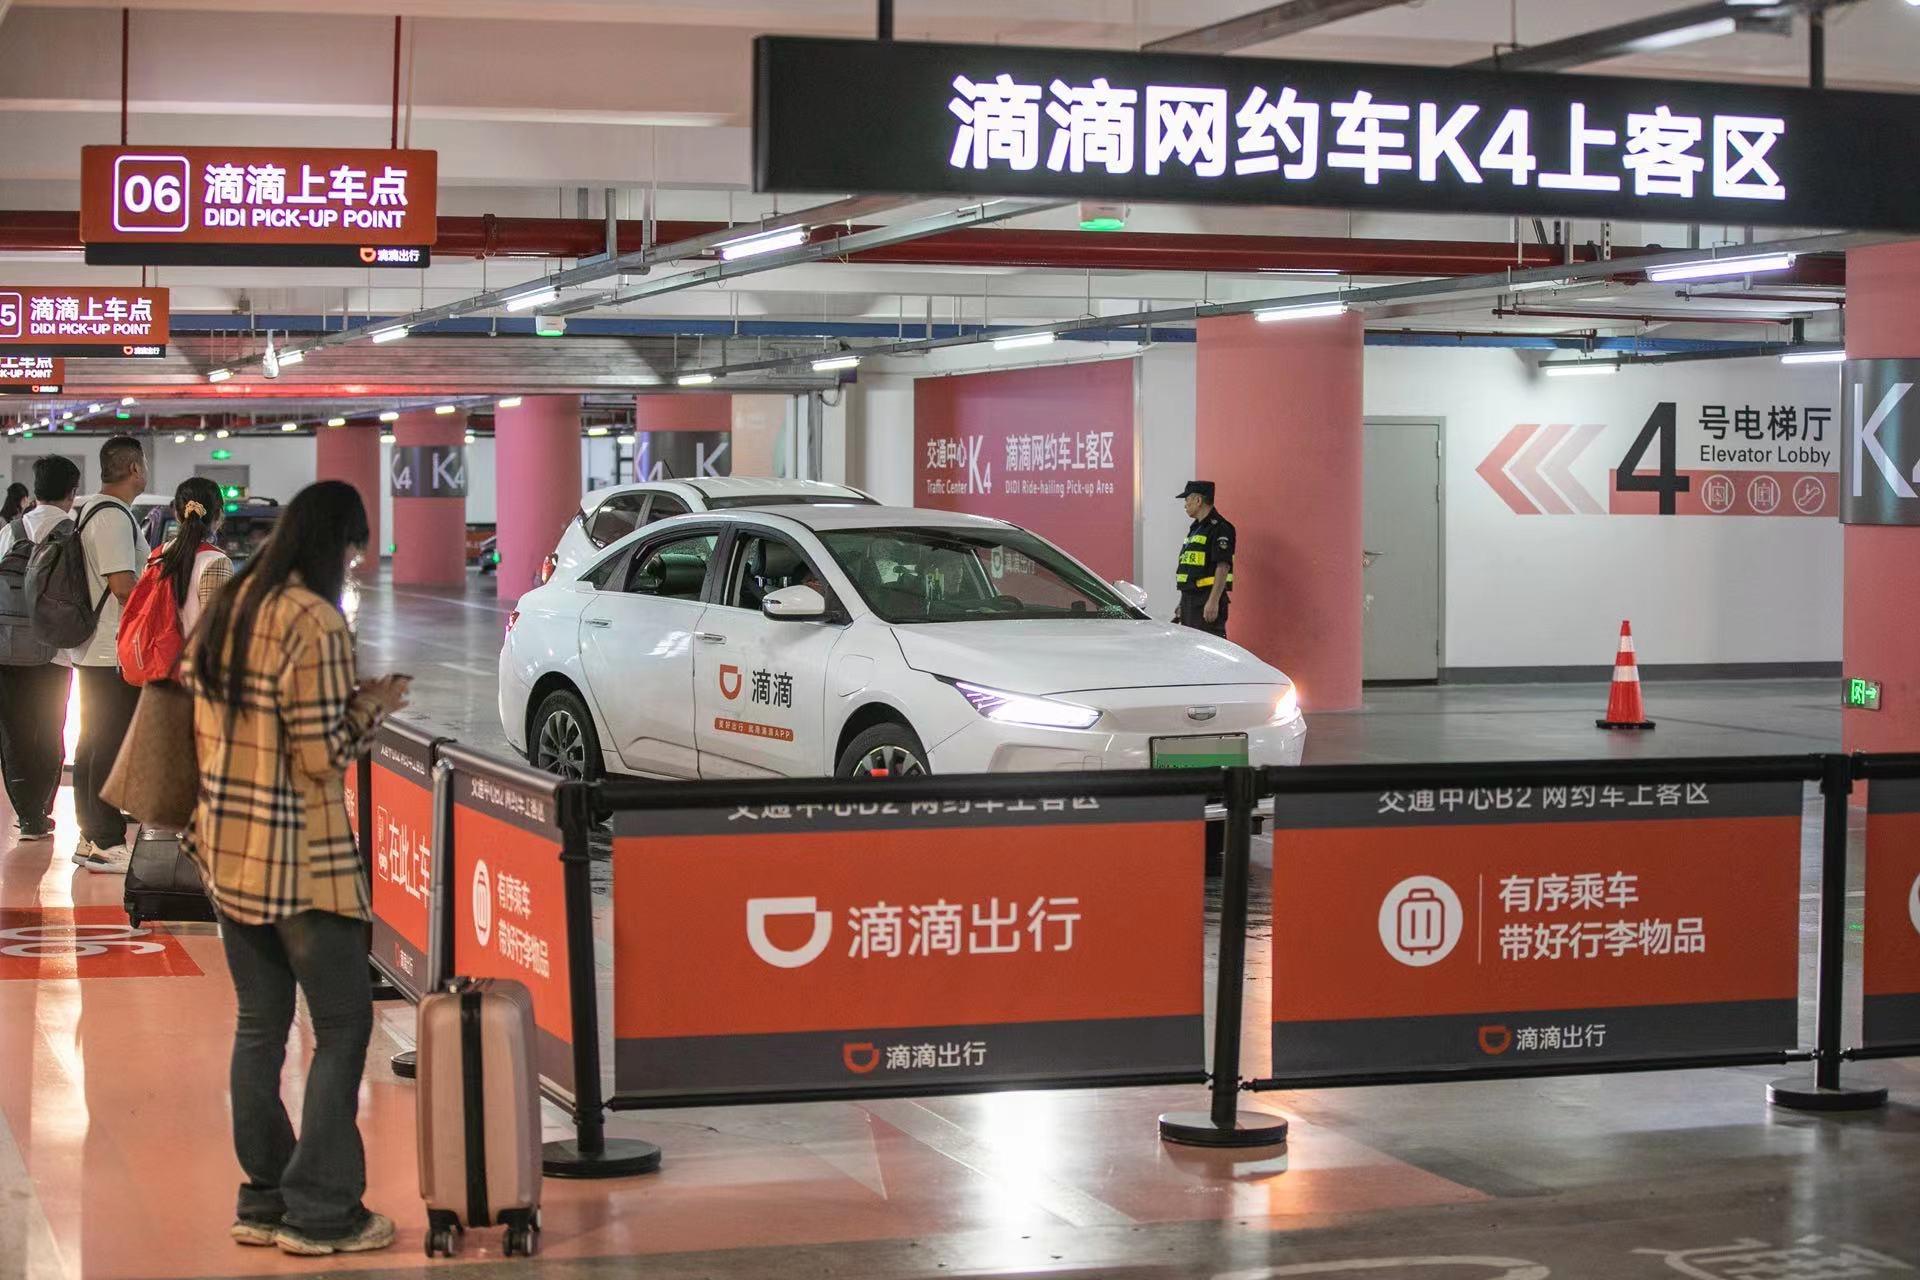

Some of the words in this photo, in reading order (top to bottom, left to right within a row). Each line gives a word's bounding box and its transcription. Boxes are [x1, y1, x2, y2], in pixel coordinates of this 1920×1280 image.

[948, 73, 1786, 200] 滴滴网约车K4上客区
[124, 175, 181, 213] 06
[204, 163, 408, 206] 滴滴上车点
[204, 208, 246, 227] DIDI
[251, 209, 338, 228] PICK-UP
[343, 210, 406, 228] POINT
[377, 249, 420, 263] 滴滴出行
[30, 296, 153, 321] 滴滴上车点
[30, 323, 56, 335] DIDI
[59, 323, 111, 335] PICK-UP
[113, 323, 151, 335] POINT
[25, 369, 52, 378] POINT
[1699, 405, 1832, 441] 号电梯厅
[1853, 382, 1920, 498] K
[927, 438, 967, 469] 交通中心
[969, 435, 992, 494] K4
[1005, 430, 1114, 471] 滴滴网约车上客区
[1616, 402, 1690, 515] 4
[1700, 445, 1772, 463] Elevator
[1778, 446, 1831, 467] Lobby
[927, 479, 945, 494] Traffic
[946, 479, 967, 494] Center
[1096, 480, 1114, 494] Area
[752, 668, 793, 709] 滴滴
[1498, 871, 1639, 912] 有序乘车
[848, 896, 1082, 959] 滴滴出行
[1498, 917, 1706, 961] 带好行李物品
[886, 1041, 988, 1070] 滴滴出行
[1516, 1024, 1606, 1052] 滴滴出行
